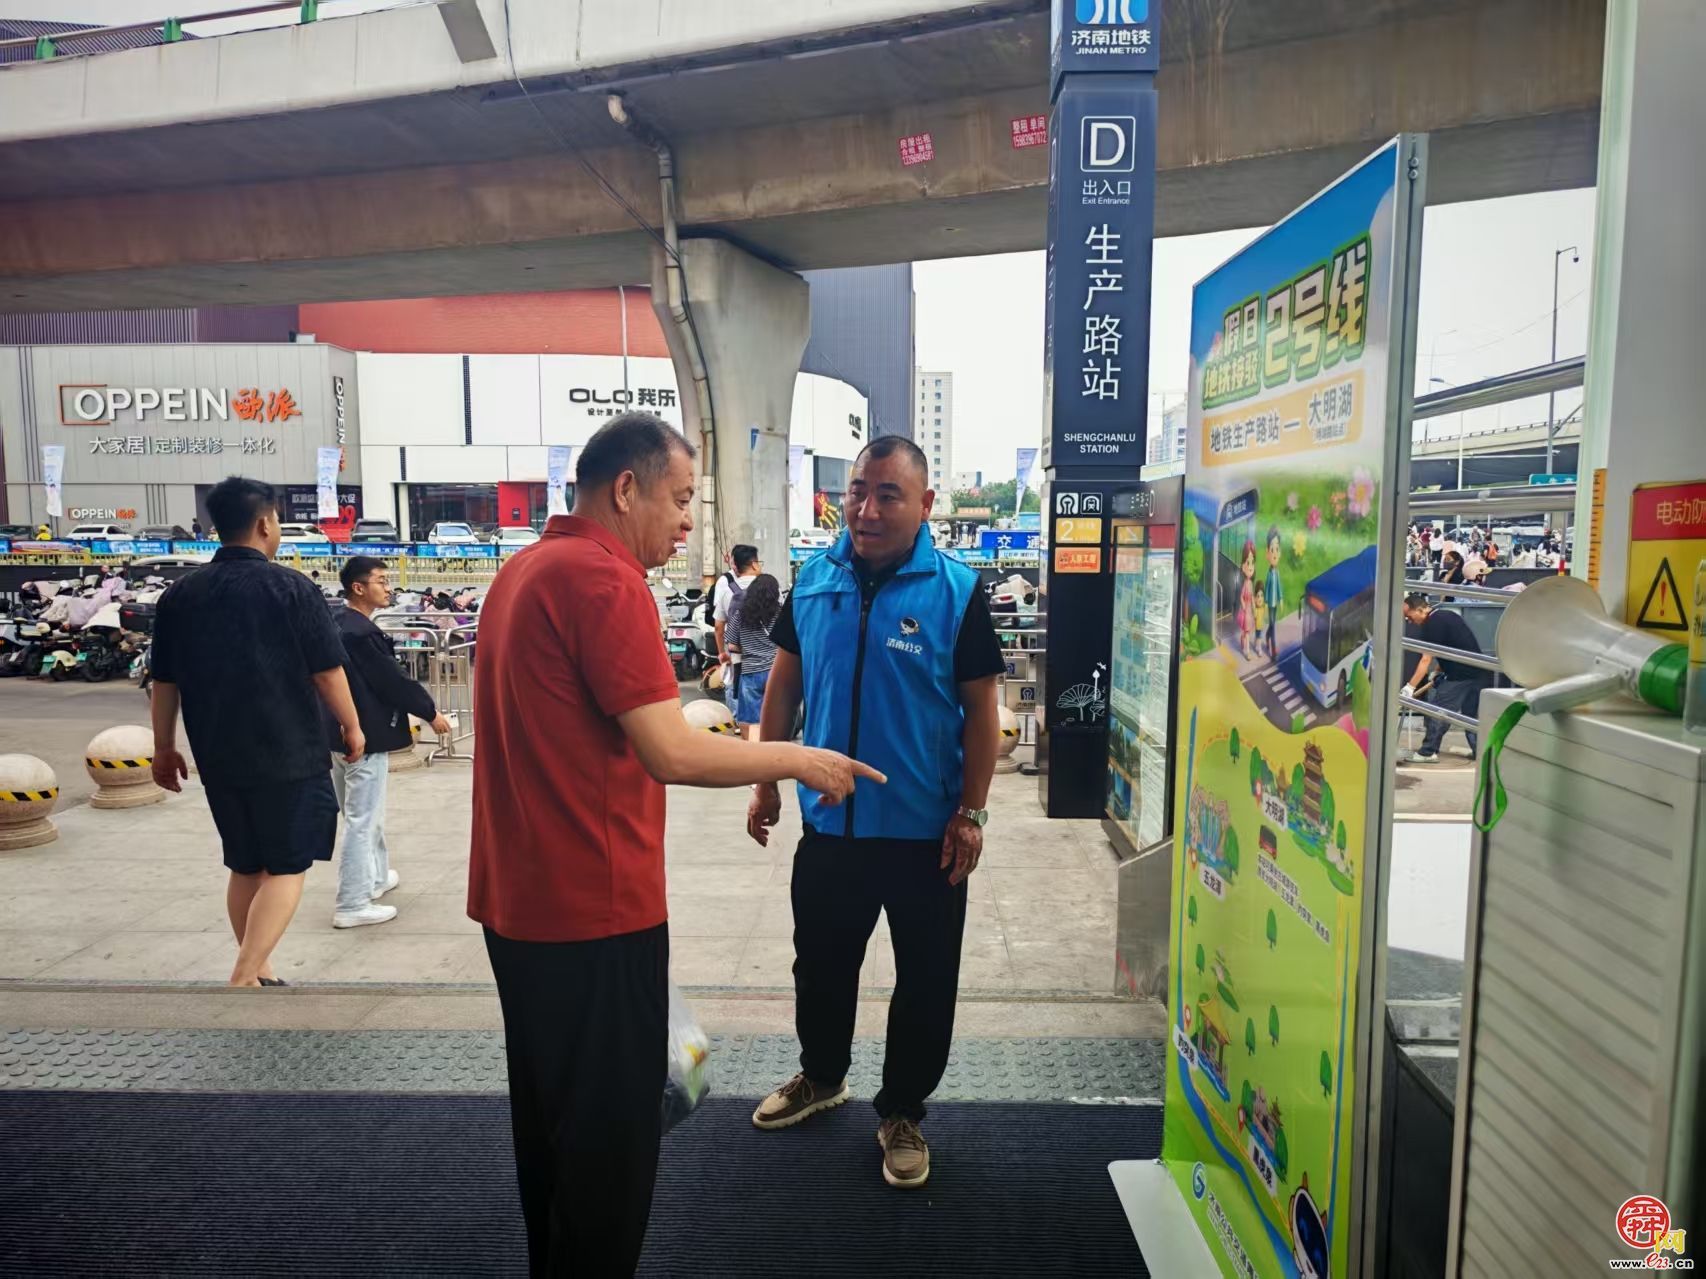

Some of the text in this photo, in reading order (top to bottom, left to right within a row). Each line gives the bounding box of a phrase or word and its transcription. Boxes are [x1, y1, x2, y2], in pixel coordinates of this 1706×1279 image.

[1071, 30, 1151, 46] 济南地铁
[1090, 123, 1126, 166] D
[1082, 179, 1131, 196] 出入口
[1082, 197, 1130, 205] Exit Entrance
[1082, 224, 1123, 400] 生产路站
[73, 387, 228, 421] OPPEIN
[637, 388, 676, 407] 我乐
[335, 380, 346, 444] OPPEIN
[1210, 412, 1280, 453] 地铁生产路站
[1309, 383, 1353, 426] 大明湖
[1064, 433, 1136, 442] SHENGCHANLU
[1080, 444, 1120, 453] STATION
[71, 508, 117, 519] OPPEIN
[1060, 519, 1074, 541] 2
